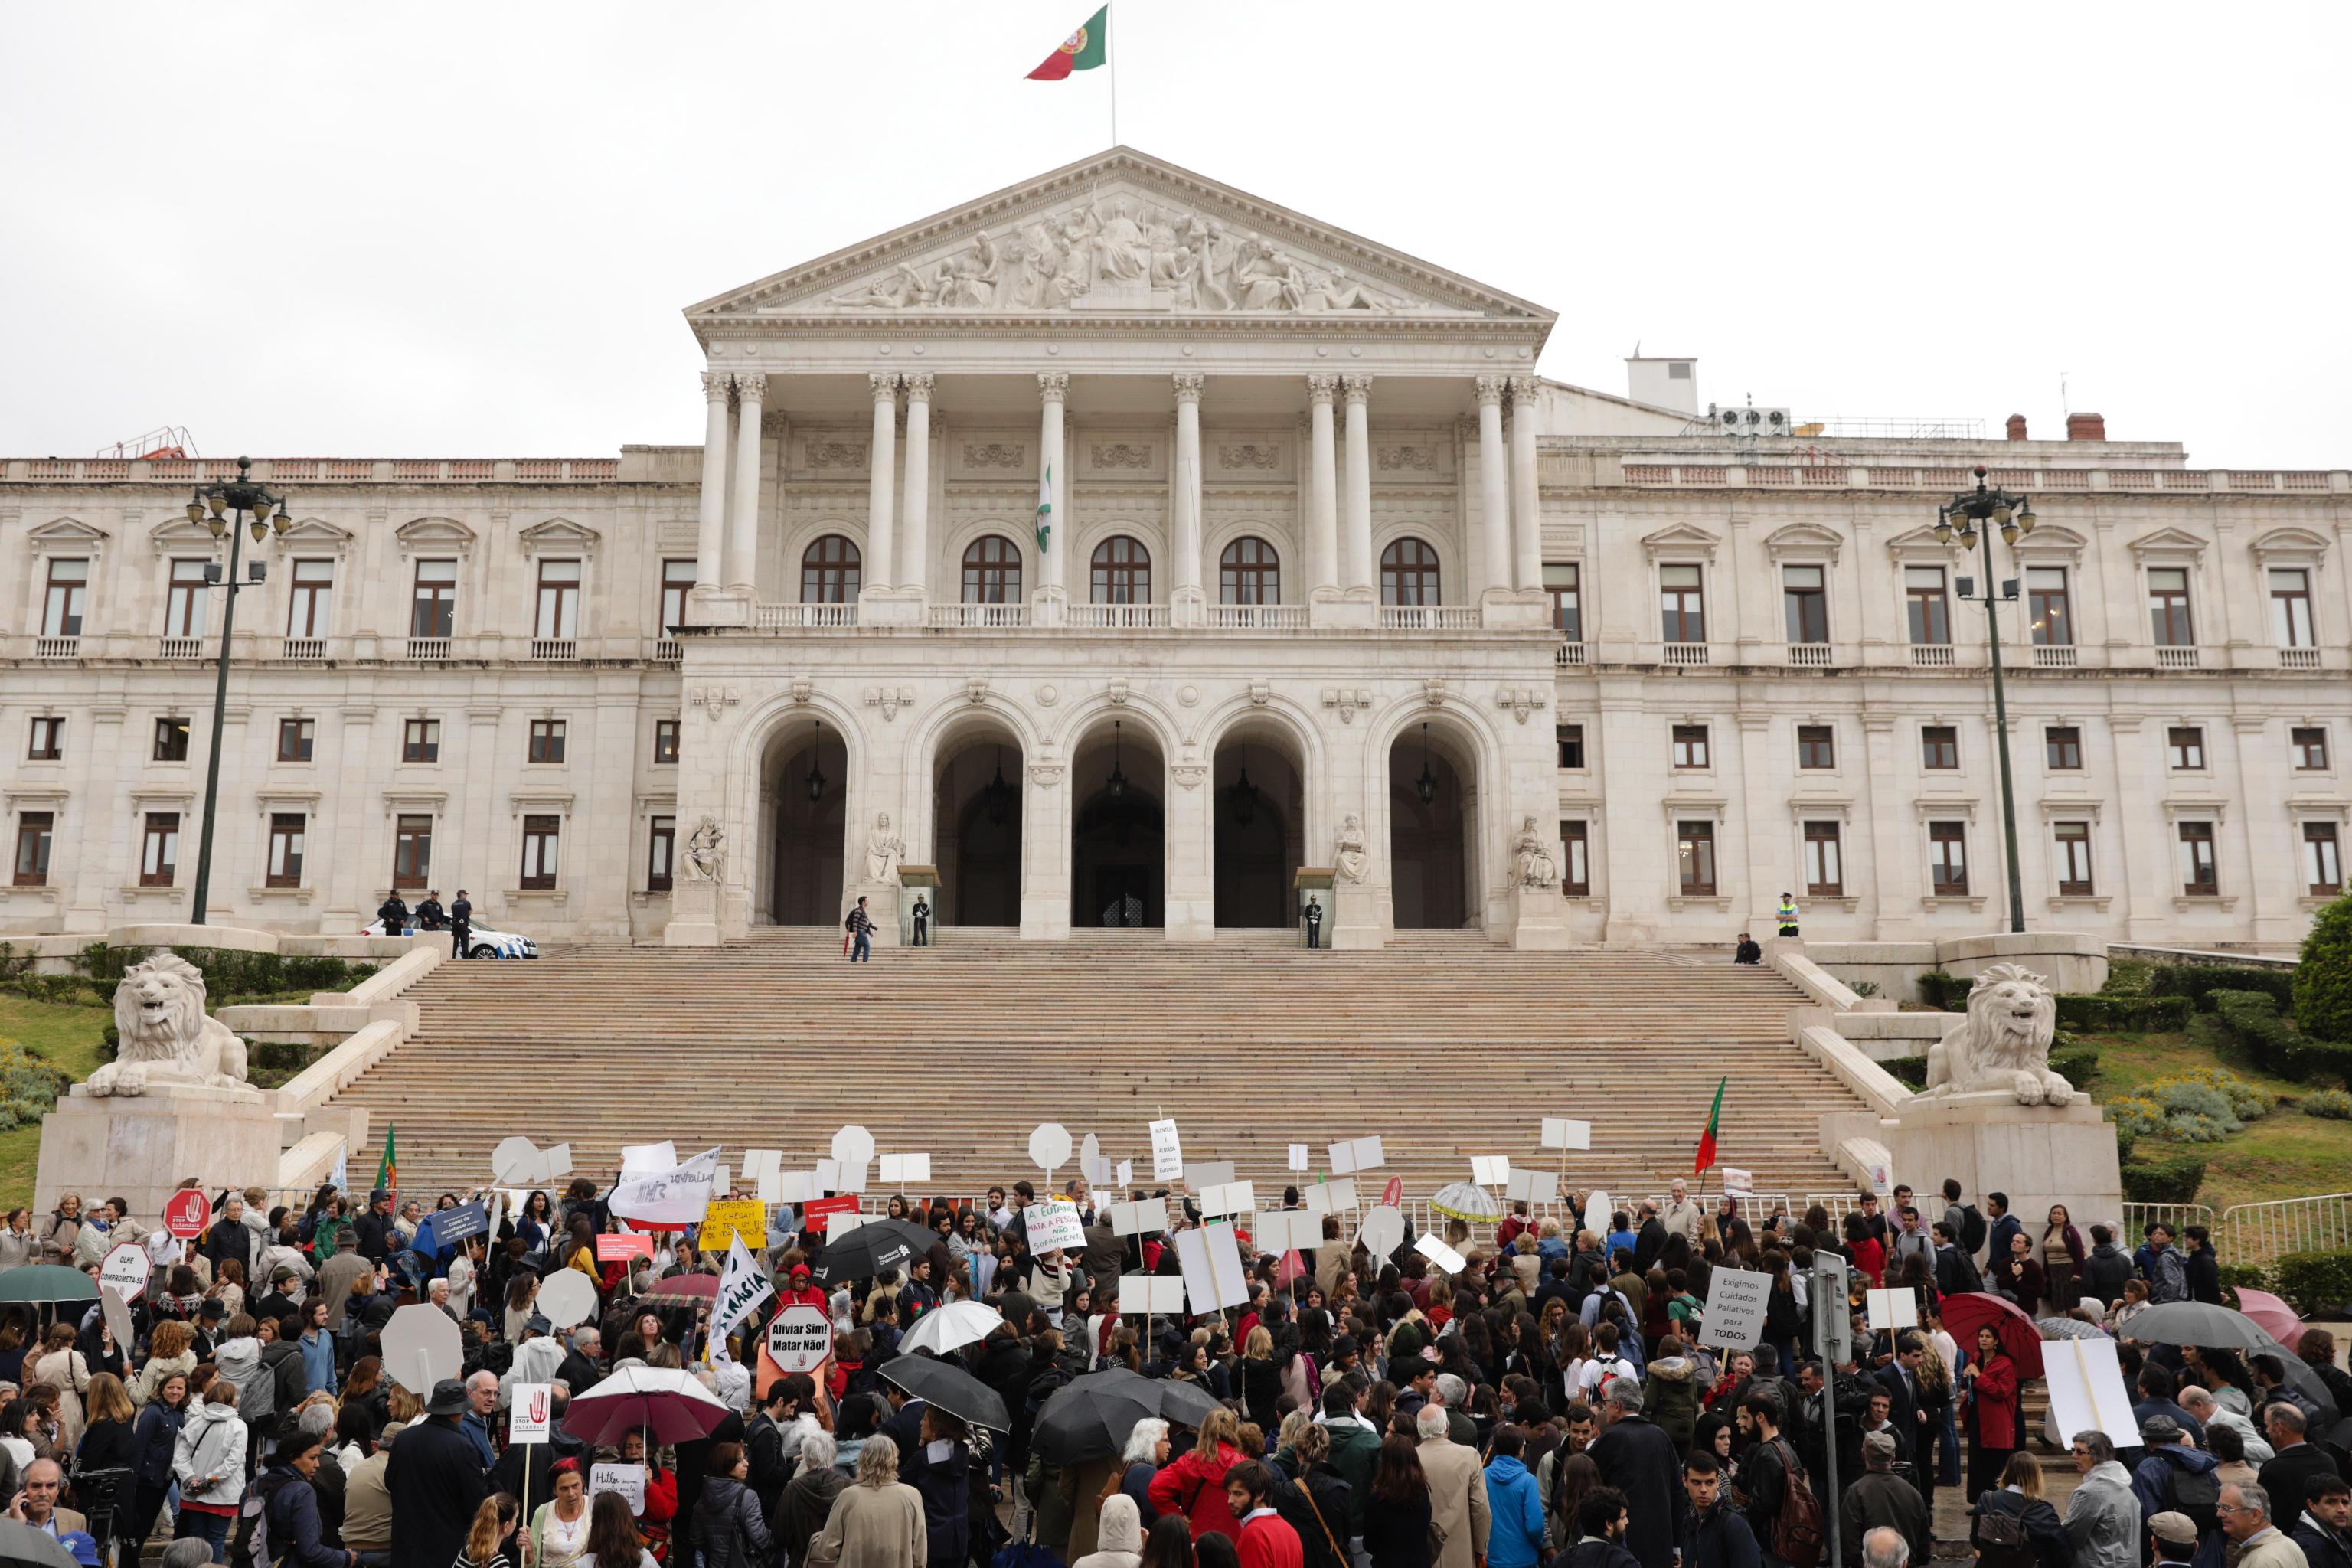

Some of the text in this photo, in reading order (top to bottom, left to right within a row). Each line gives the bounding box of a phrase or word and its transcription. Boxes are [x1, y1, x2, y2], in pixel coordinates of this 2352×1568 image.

[716, 1201, 755, 1210] IMPOSTOS
[723, 1212, 754, 1220] CHEGAM
[1028, 1210, 1037, 1220] A
[441, 1223, 467, 1235] reconhecer
[455, 1225, 478, 1236] dignidade
[1027, 1222, 1047, 1232] MATA
[1053, 1226, 1069, 1234] NÃO
[119, 1256, 135, 1264] OLHE
[878, 1249, 899, 1261] Standard
[879, 1253, 901, 1266] Chartered
[100, 1273, 144, 1285] COMPROMETA-SE
[1723, 1278, 1759, 1289] Exigimos
[1720, 1291, 1757, 1303] Cuidados
[1717, 1303, 1755, 1315] Paliativos
[772, 1323, 828, 1334] Aliviar Sim!
[1714, 1329, 1746, 1341] TODOS
[773, 1339, 825, 1351] Matar Não!
[596, 1471, 619, 1484] Hitler
